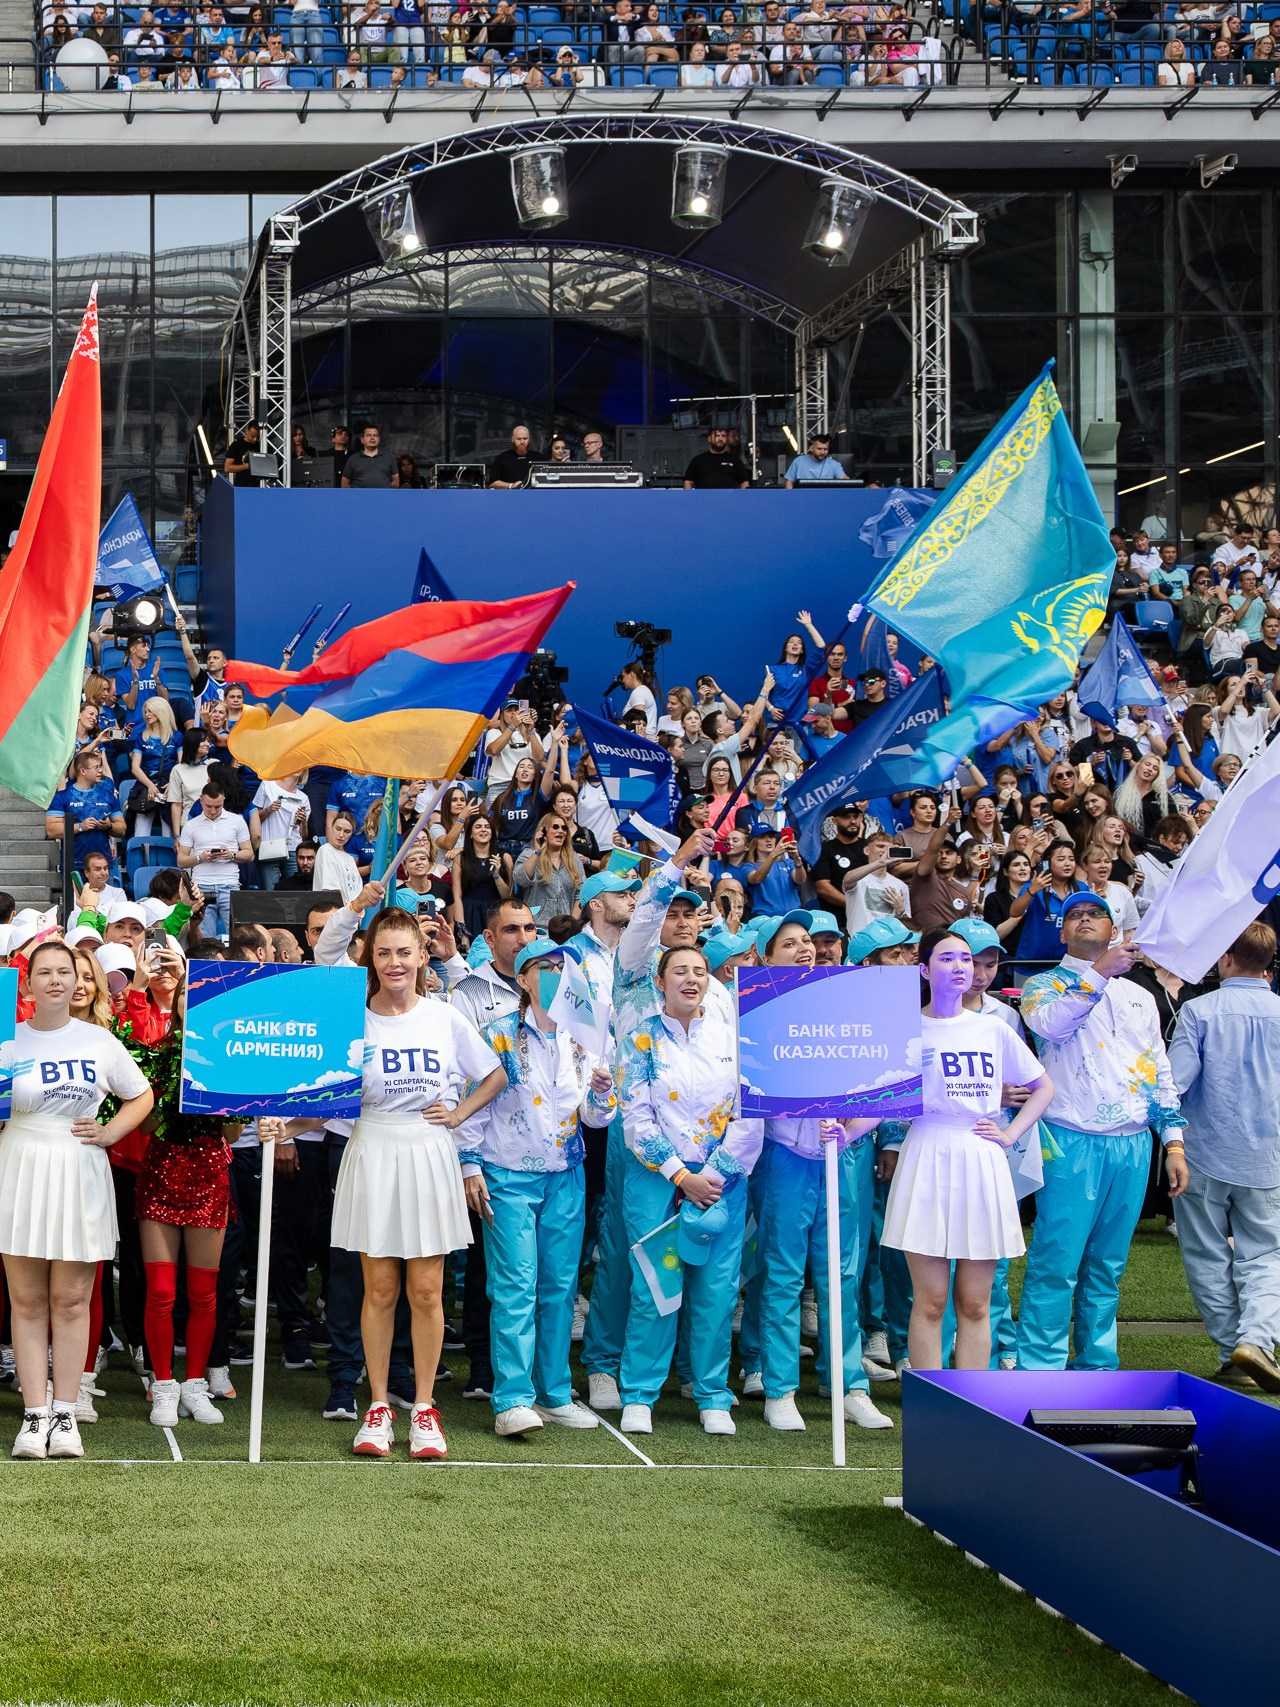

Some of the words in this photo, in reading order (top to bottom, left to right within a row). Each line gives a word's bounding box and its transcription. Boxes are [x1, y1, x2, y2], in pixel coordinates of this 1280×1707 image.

[507, 810, 528, 820] ВТБ
[234, 1020, 282, 1036] БАНК
[285, 1021, 317, 1037] ВТБ
[788, 1024, 836, 1038] БАНК
[841, 1024, 873, 1038] ВТБ
[225, 1040, 324, 1061] (АРМЕНИЯ)
[773, 1044, 889, 1061] (КАЗАХСТАН)
[382, 1048, 440, 1074] ВТБ
[940, 1052, 994, 1079] ВТБ
[40, 1060, 96, 1085] ВТБ
